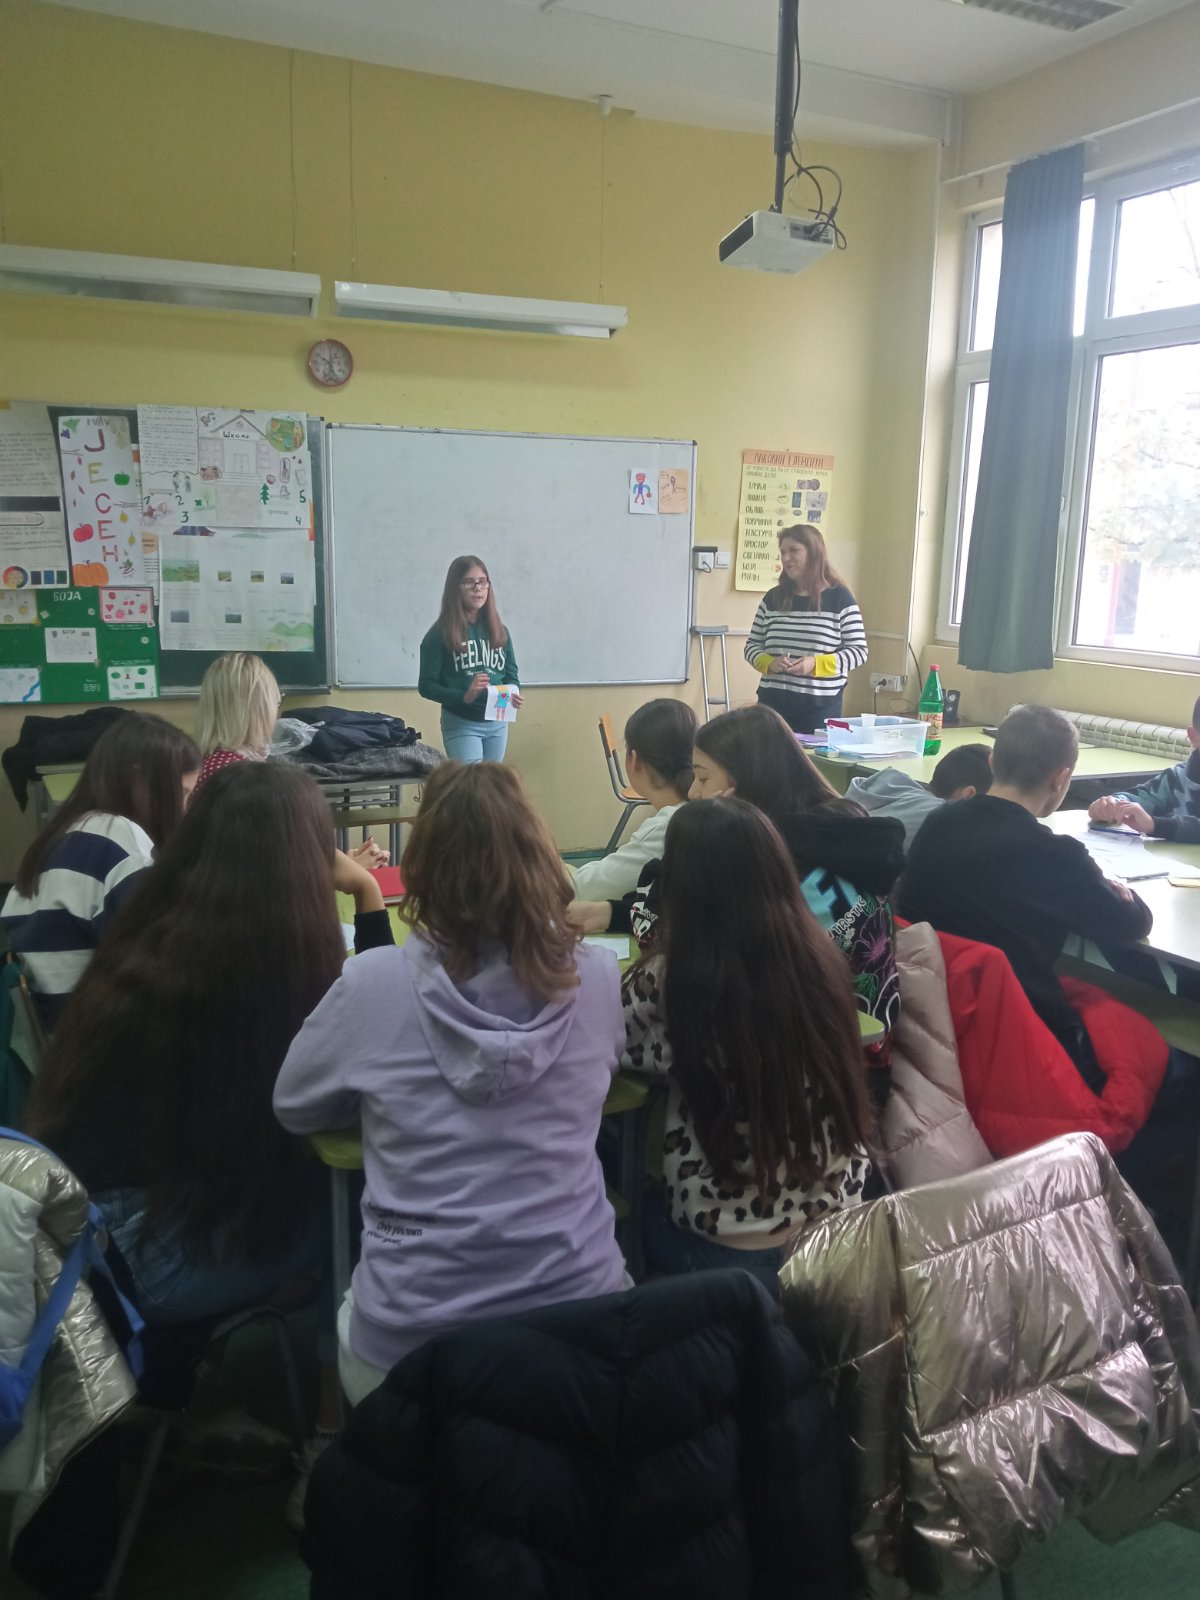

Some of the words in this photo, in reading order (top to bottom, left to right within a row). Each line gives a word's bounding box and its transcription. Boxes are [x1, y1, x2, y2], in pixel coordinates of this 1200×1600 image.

[174, 495, 185, 506] 2
[299, 489, 307, 503] 5
[180, 511, 190, 523] 3
[295, 515, 302, 525] 4
[453, 638, 506, 673] FEELNGS
